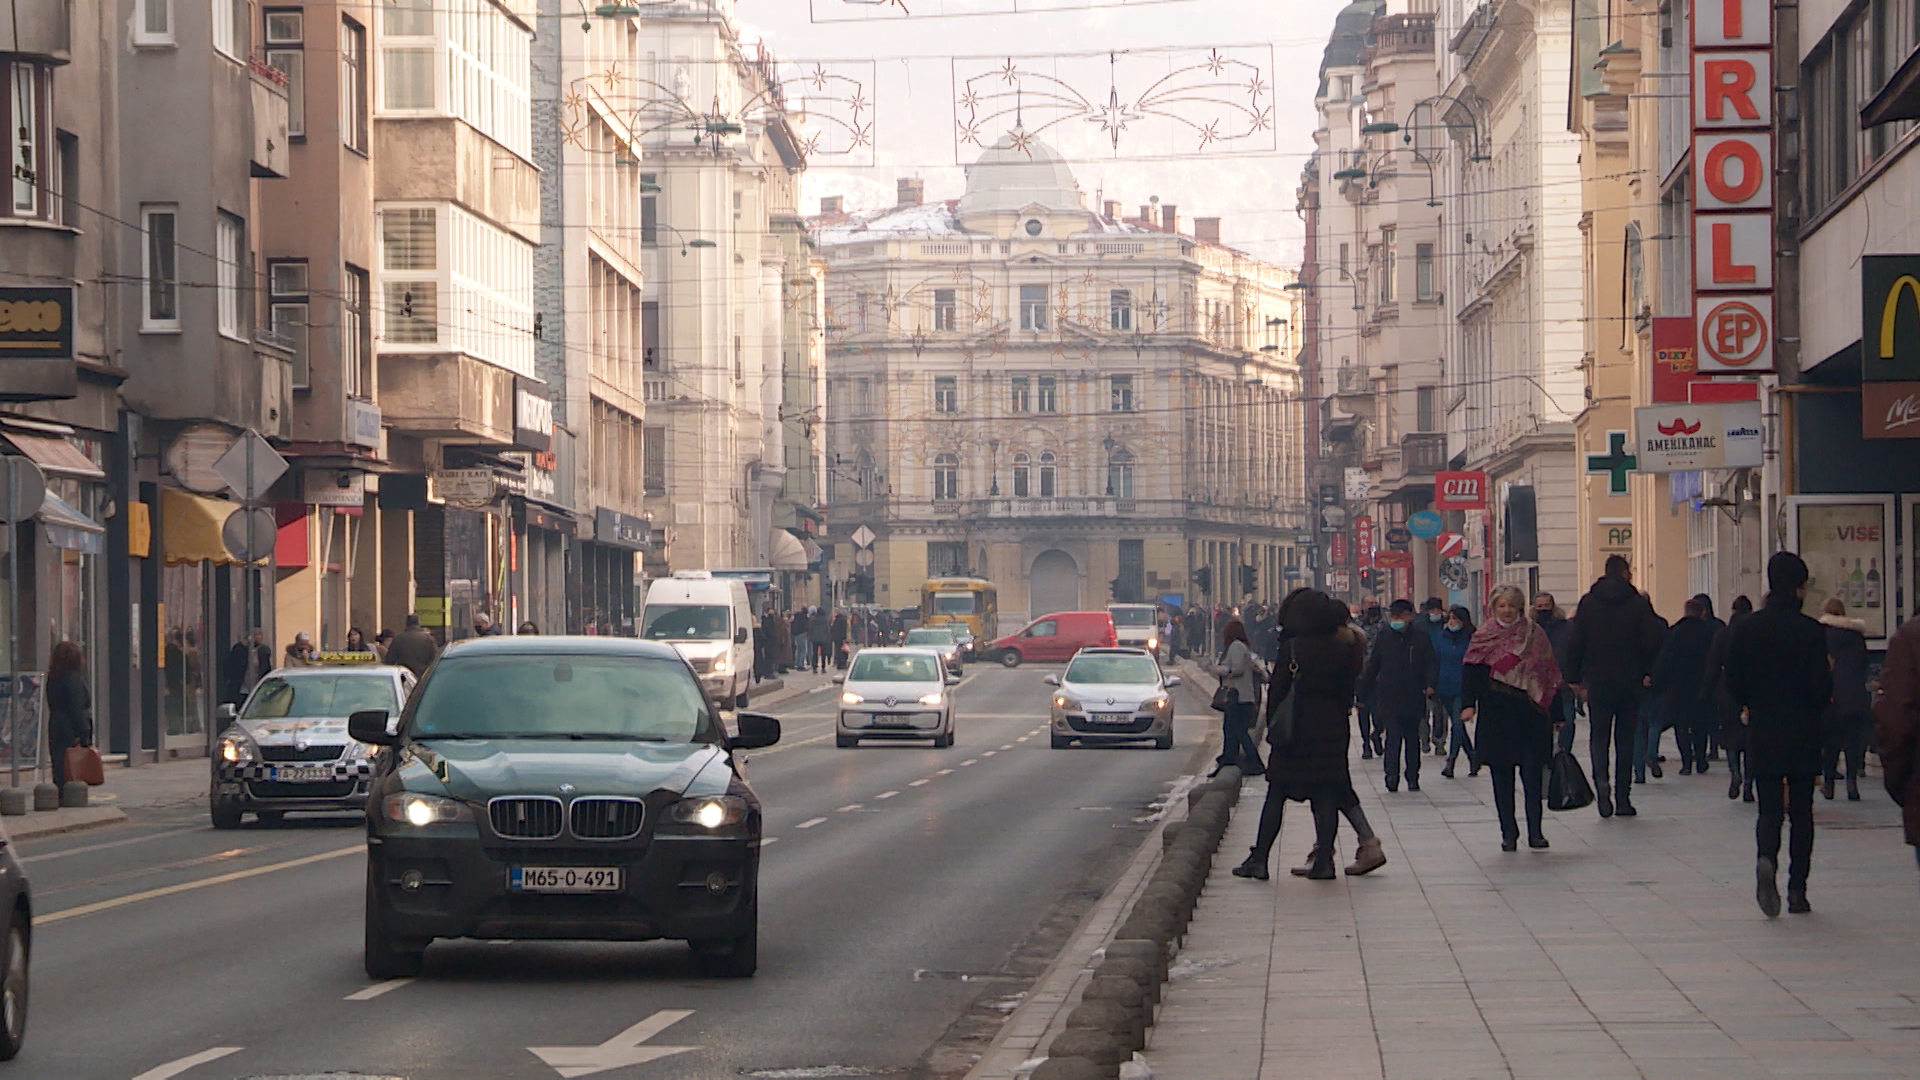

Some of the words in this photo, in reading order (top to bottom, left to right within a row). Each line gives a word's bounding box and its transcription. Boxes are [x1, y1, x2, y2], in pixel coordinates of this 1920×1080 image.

[1716, 312, 1758, 354] EP
[1647, 436, 1716, 452] AMERIKANAC
[1443, 478, 1478, 495] cm
